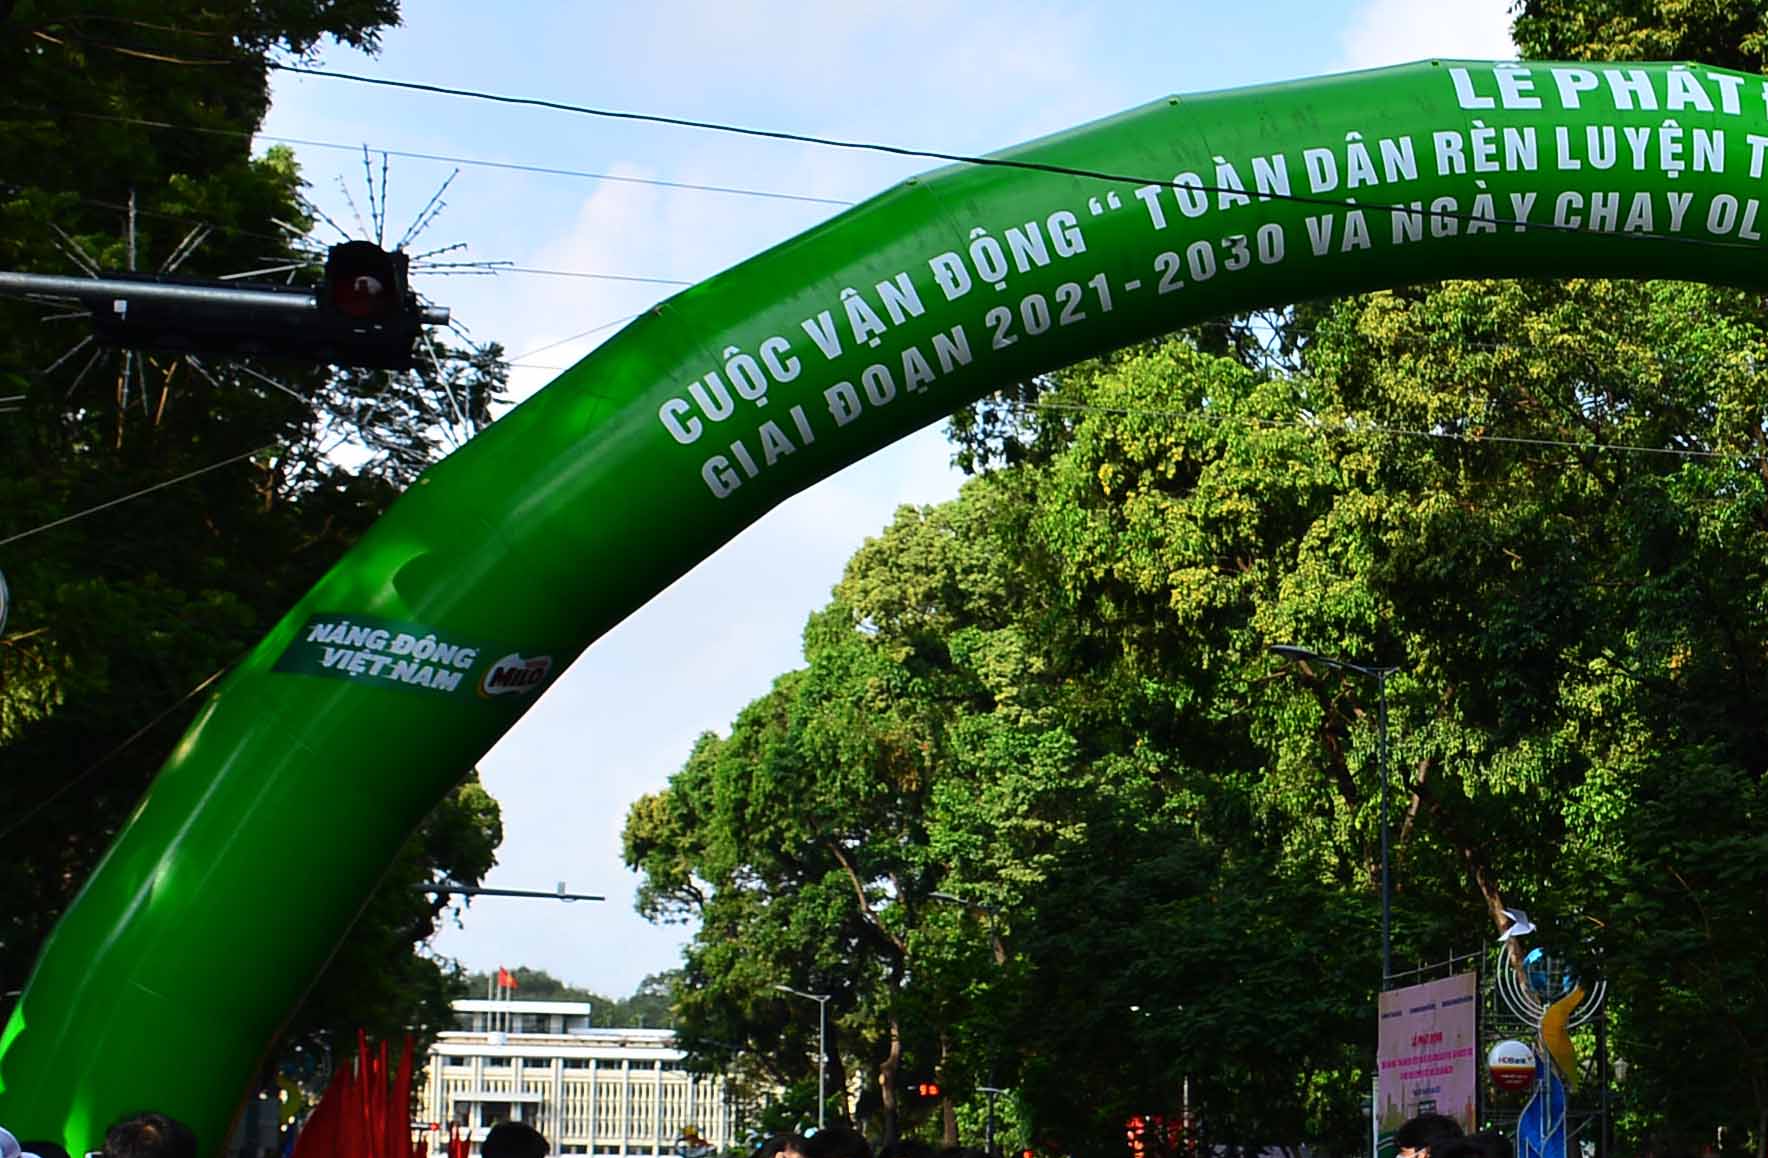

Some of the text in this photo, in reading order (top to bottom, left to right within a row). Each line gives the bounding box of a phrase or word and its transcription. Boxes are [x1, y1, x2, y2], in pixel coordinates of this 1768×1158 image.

[658, 344, 803, 446] CUỘC
[800, 270, 926, 362] VẬN
[928, 227, 1087, 301] ĐỘNG
[1303, 131, 1419, 194] DÂN
[1432, 120, 1540, 177] RÈN
[1556, 119, 1726, 179] LUYỆN
[700, 402, 817, 500] GIAI
[822, 323, 974, 430] ĐOẠN
[984, 272, 1114, 352] 2021
[1123, 278, 1143, 293] -
[1153, 222, 1287, 296] 2030
[1304, 197, 1373, 258] VÀ
[1390, 178, 1538, 246] NGÀY
[384, 660, 464, 692] NAM
